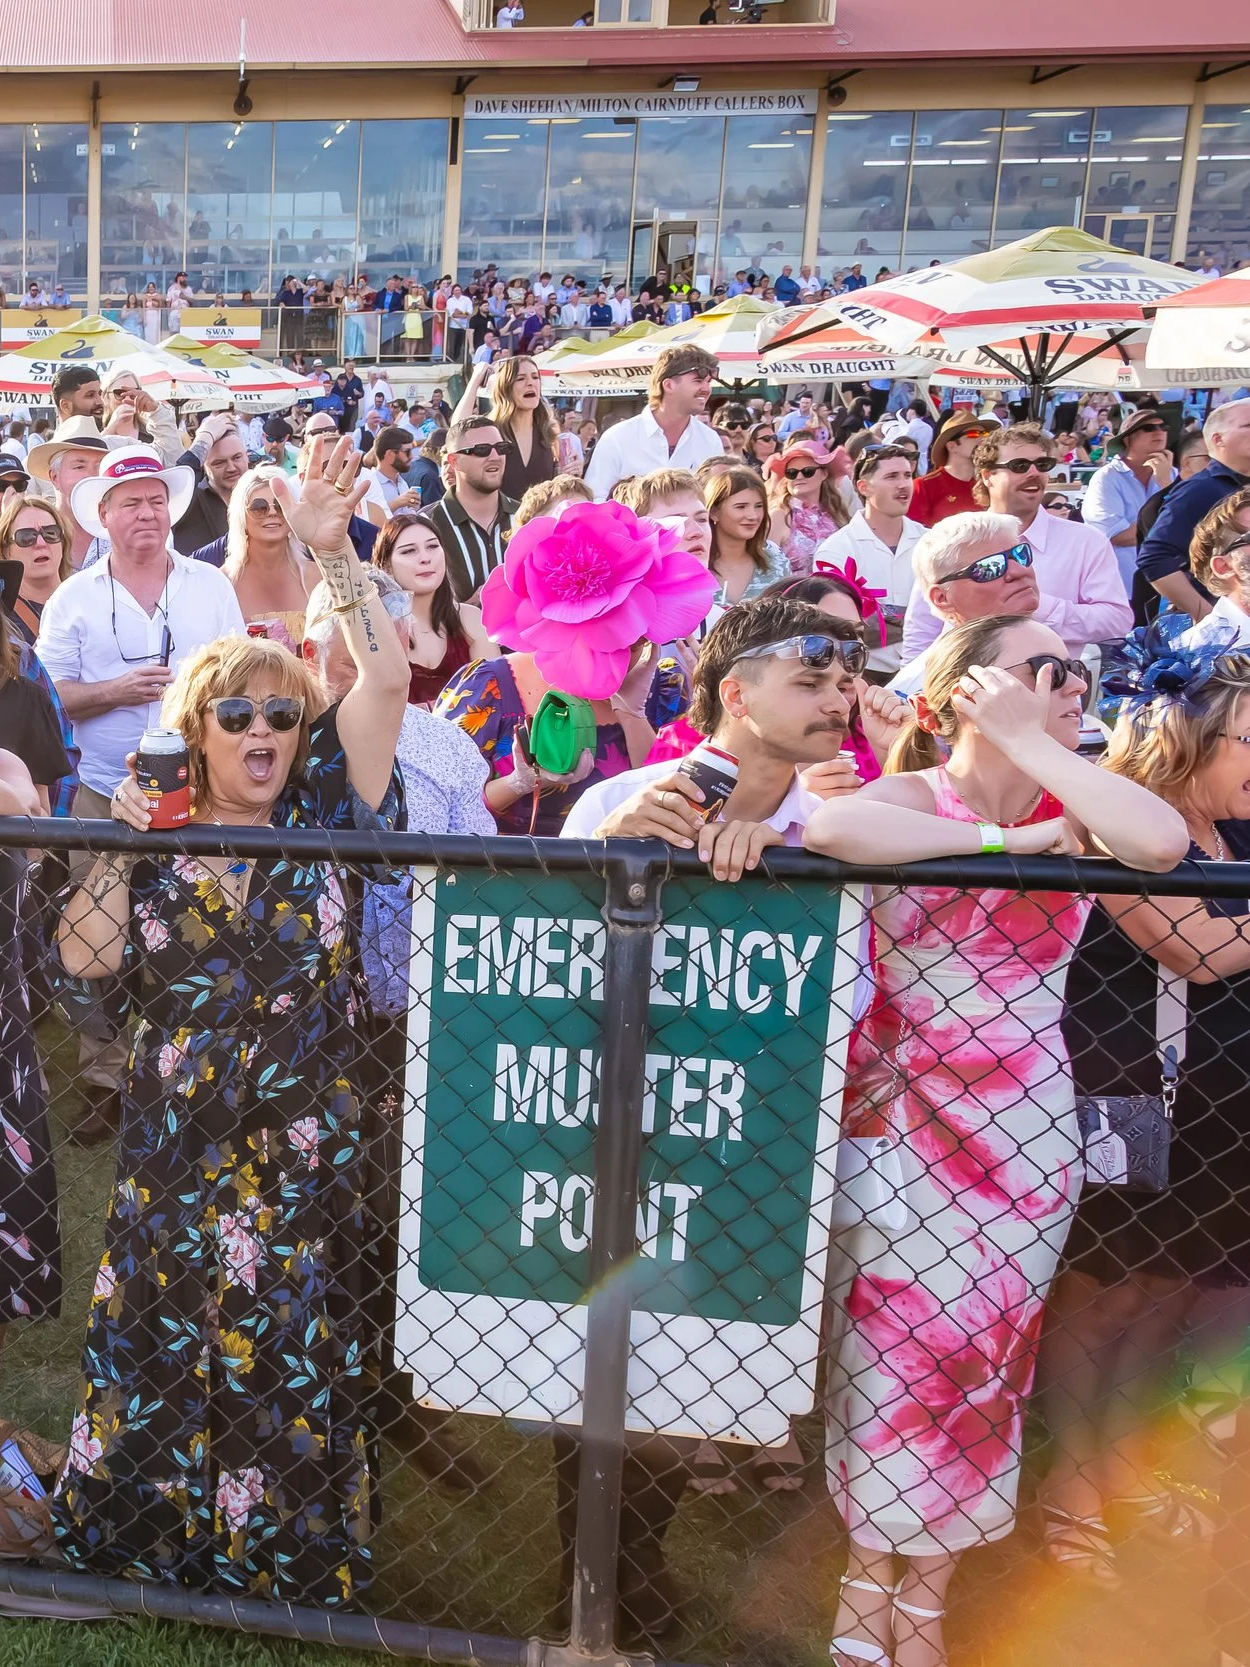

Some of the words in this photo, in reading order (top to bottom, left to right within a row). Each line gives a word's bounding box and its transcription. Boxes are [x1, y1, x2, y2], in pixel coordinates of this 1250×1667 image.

[474, 99, 507, 114] DAVE
[511, 98, 631, 114] SHEEHAN/MILTON
[634, 96, 712, 112] CAIRNDUFF
[714, 95, 774, 111] CALLERS
[777, 94, 806, 110] BOX
[758, 363, 805, 374] SWAN
[809, 359, 896, 374] DRAUGHT
[958, 376, 991, 385] SWAN
[442, 914, 823, 1016] EMERENCY
[492, 1043, 747, 1142] MUTER
[519, 1171, 704, 1262] PONT
